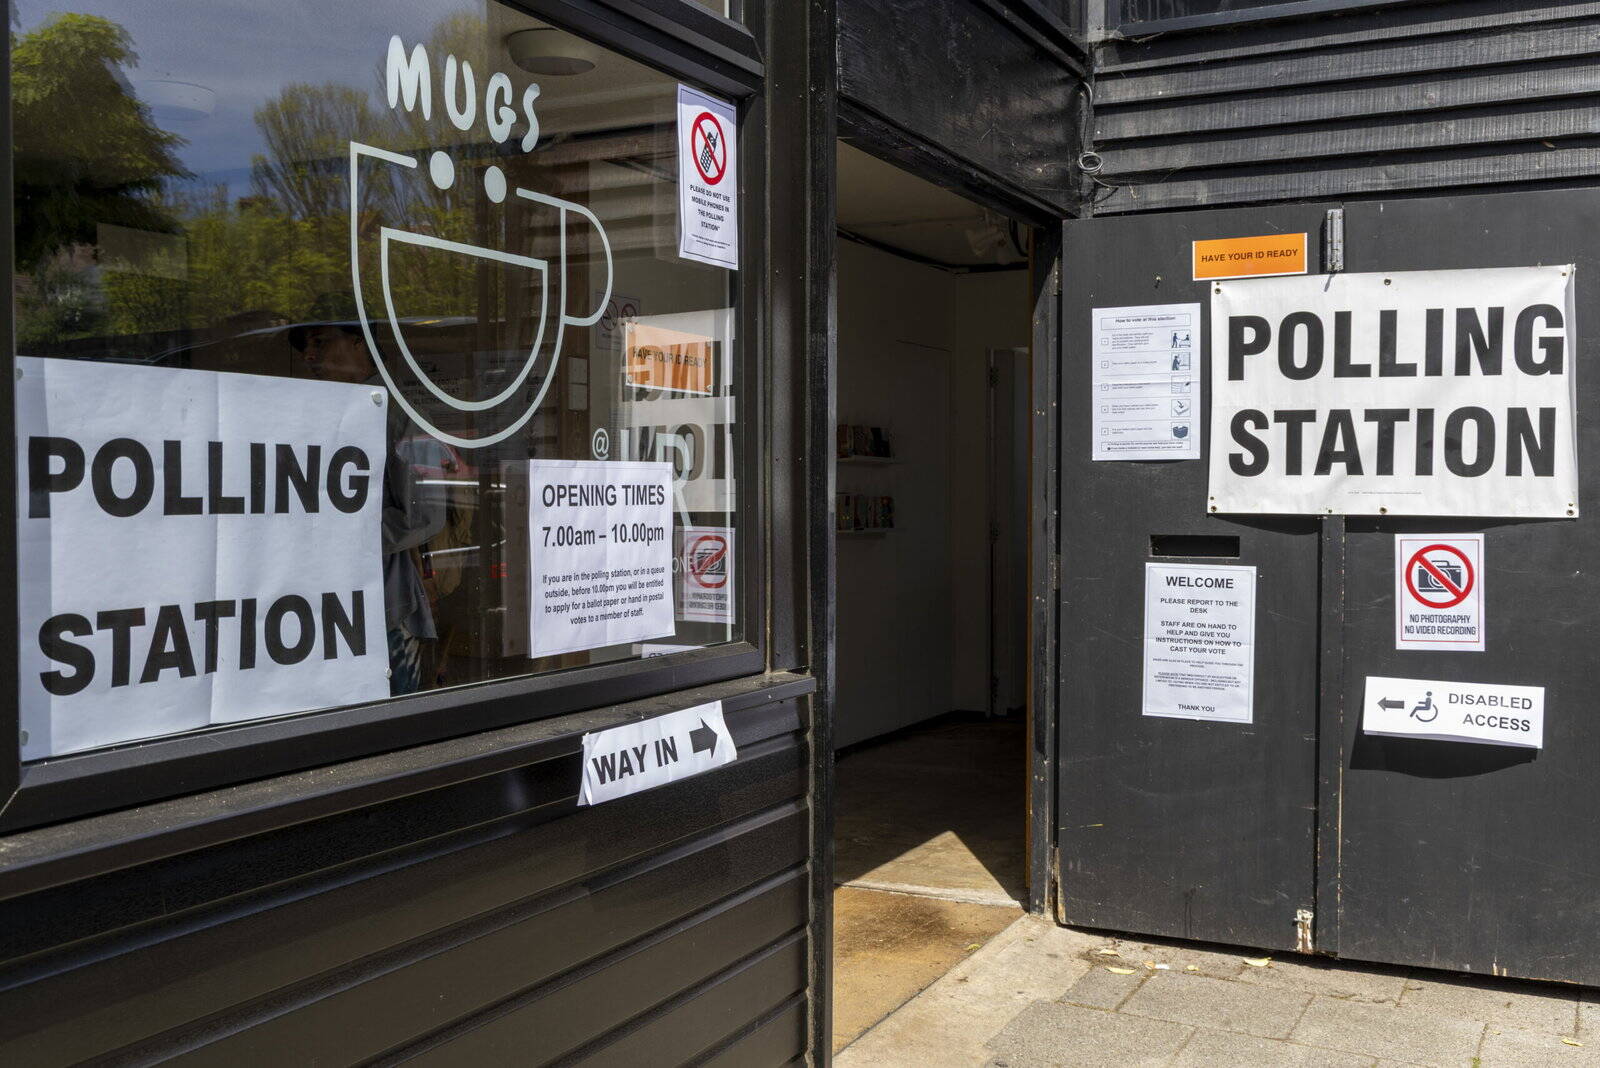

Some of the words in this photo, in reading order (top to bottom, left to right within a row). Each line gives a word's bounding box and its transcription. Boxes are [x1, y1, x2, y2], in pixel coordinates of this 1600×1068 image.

[386, 35, 540, 153] MUGS
[690, 184, 705, 195] PLEASE
[692, 196, 706, 206] MOBILE
[707, 201, 724, 212] PHONES
[706, 212, 724, 222] POLLING
[1201, 254, 1225, 262] HAVE
[1228, 252, 1252, 260] YOUR
[1266, 249, 1298, 258] READY
[1228, 303, 1564, 382] POLLING
[633, 346, 652, 360] HAVE
[653, 350, 673, 362] YOUR
[675, 354, 681, 364] ID
[592, 428, 609, 460] @
[1228, 406, 1556, 478] STATION
[28, 436, 370, 519] POLLING
[542, 484, 617, 507] OPENING
[622, 484, 665, 506] TIMES
[542, 525, 595, 547] 7.00am
[611, 523, 664, 546] 10.00pm
[543, 574, 547, 584] If
[548, 576, 560, 585] you
[581, 572, 590, 580] the
[591, 570, 609, 580] polling
[611, 568, 632, 577] station,
[651, 566, 665, 575] queue
[1166, 576, 1234, 588] WELCOME
[545, 588, 571, 599] outside,
[572, 586, 590, 596] before
[592, 584, 614, 594] 10.00pm
[616, 584, 627, 593] you
[628, 581, 637, 589] will
[646, 578, 664, 588] entitled
[553, 603, 570, 613] apply
[572, 601, 581, 610] for
[586, 599, 602, 608] ballot
[603, 598, 619, 608] paper
[628, 595, 641, 603] hand
[649, 592, 664, 602] postal
[570, 615, 587, 624] votes
[600, 611, 622, 620] member
[623, 609, 630, 617] of
[1410, 614, 1419, 623] NO
[1421, 614, 1471, 624] PHOTOGRAPHY
[1405, 626, 1414, 634] NO
[1416, 626, 1436, 634] VIDEO
[1437, 626, 1476, 635] RECORDING
[38, 590, 366, 696] STATION
[1448, 693, 1533, 710] DISABLED
[1463, 714, 1531, 732] ACCESS
[592, 744, 647, 785] WAY
[654, 736, 678, 767] IN
